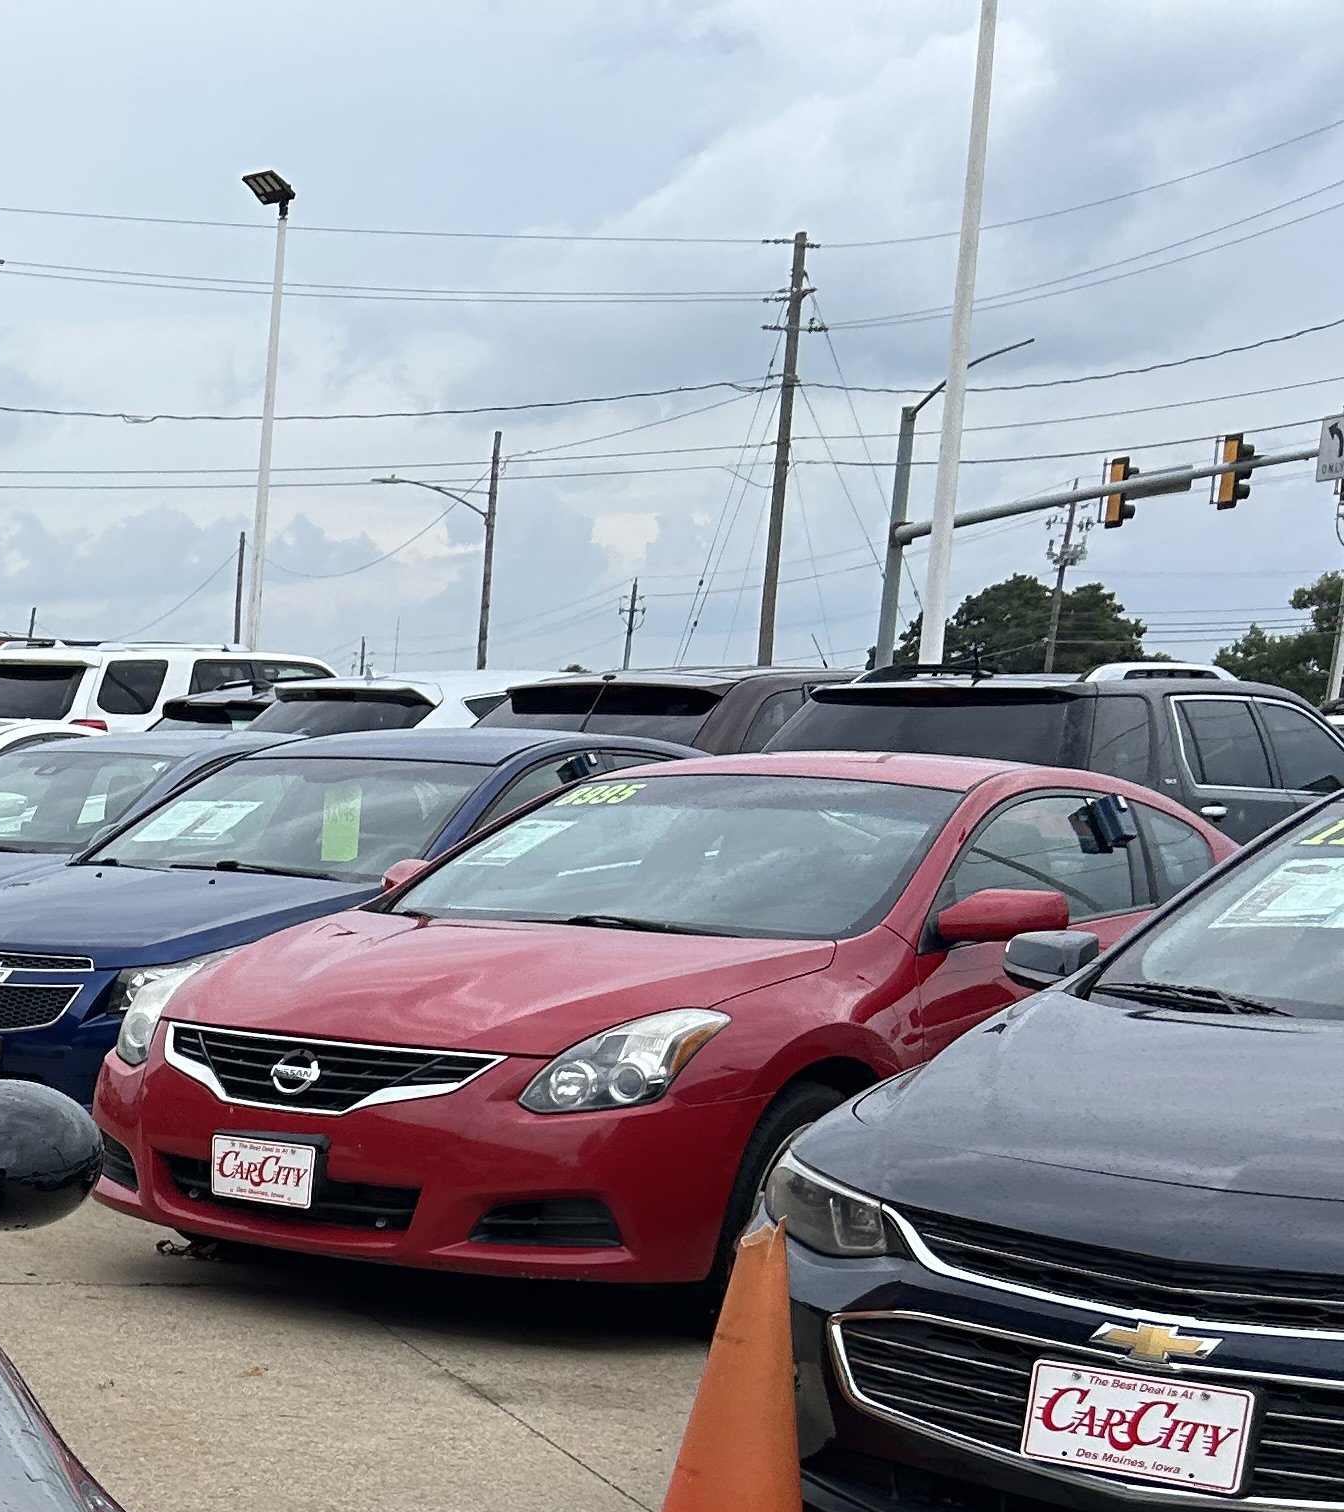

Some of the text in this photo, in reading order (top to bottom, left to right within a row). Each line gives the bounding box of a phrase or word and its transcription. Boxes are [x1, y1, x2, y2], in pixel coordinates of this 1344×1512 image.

[1321, 461, 1344, 475] ONLY
[554, 783, 647, 807] 8995
[1088, 1375, 1108, 1388] The
[1113, 1379, 1137, 1391] Best
[1139, 1382, 1164, 1396] Deal
[1180, 1389, 1195, 1401] At
[1075, 1448, 1099, 1461] Des
[1151, 1461, 1182, 1475] Iowa
